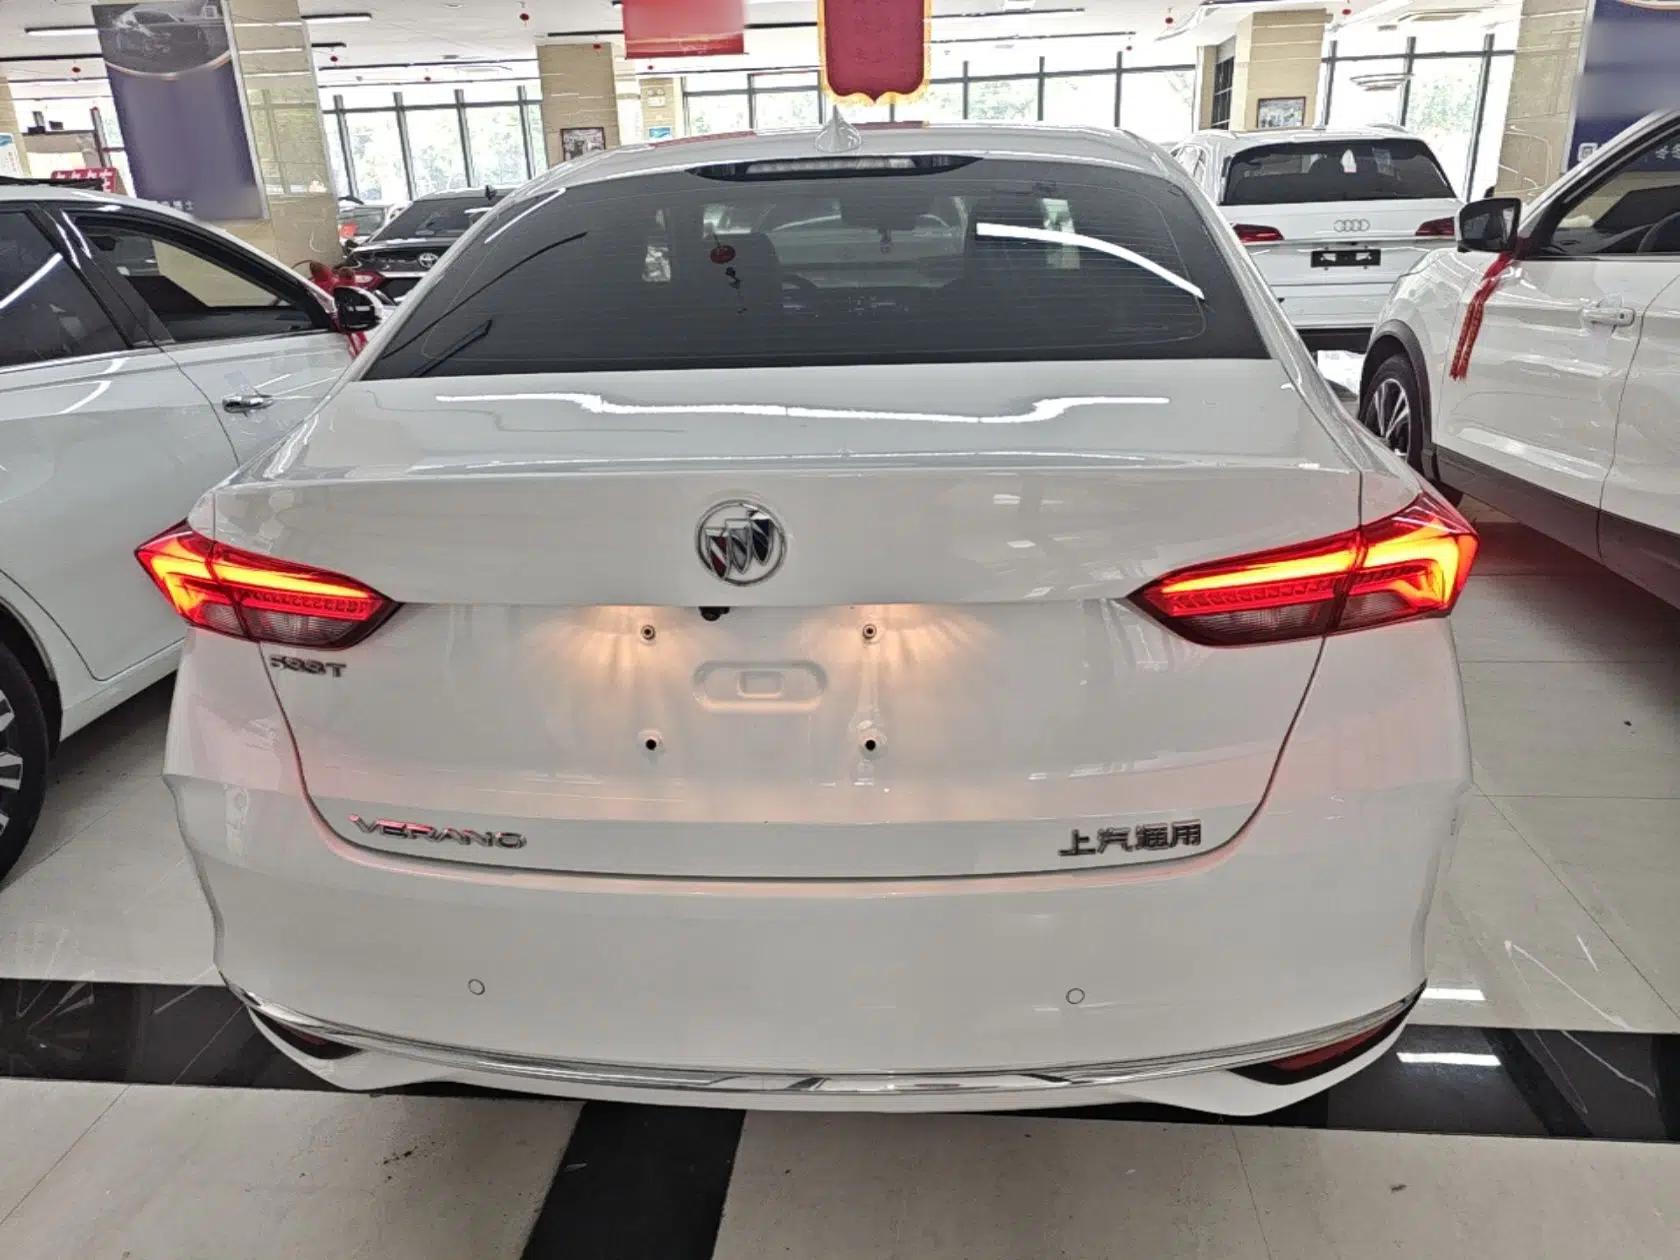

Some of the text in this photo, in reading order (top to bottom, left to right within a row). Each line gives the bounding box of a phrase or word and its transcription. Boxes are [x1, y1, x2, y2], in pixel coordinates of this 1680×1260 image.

[348, 814, 527, 849] VERANO
[1058, 819, 1202, 856] 上汽通用
